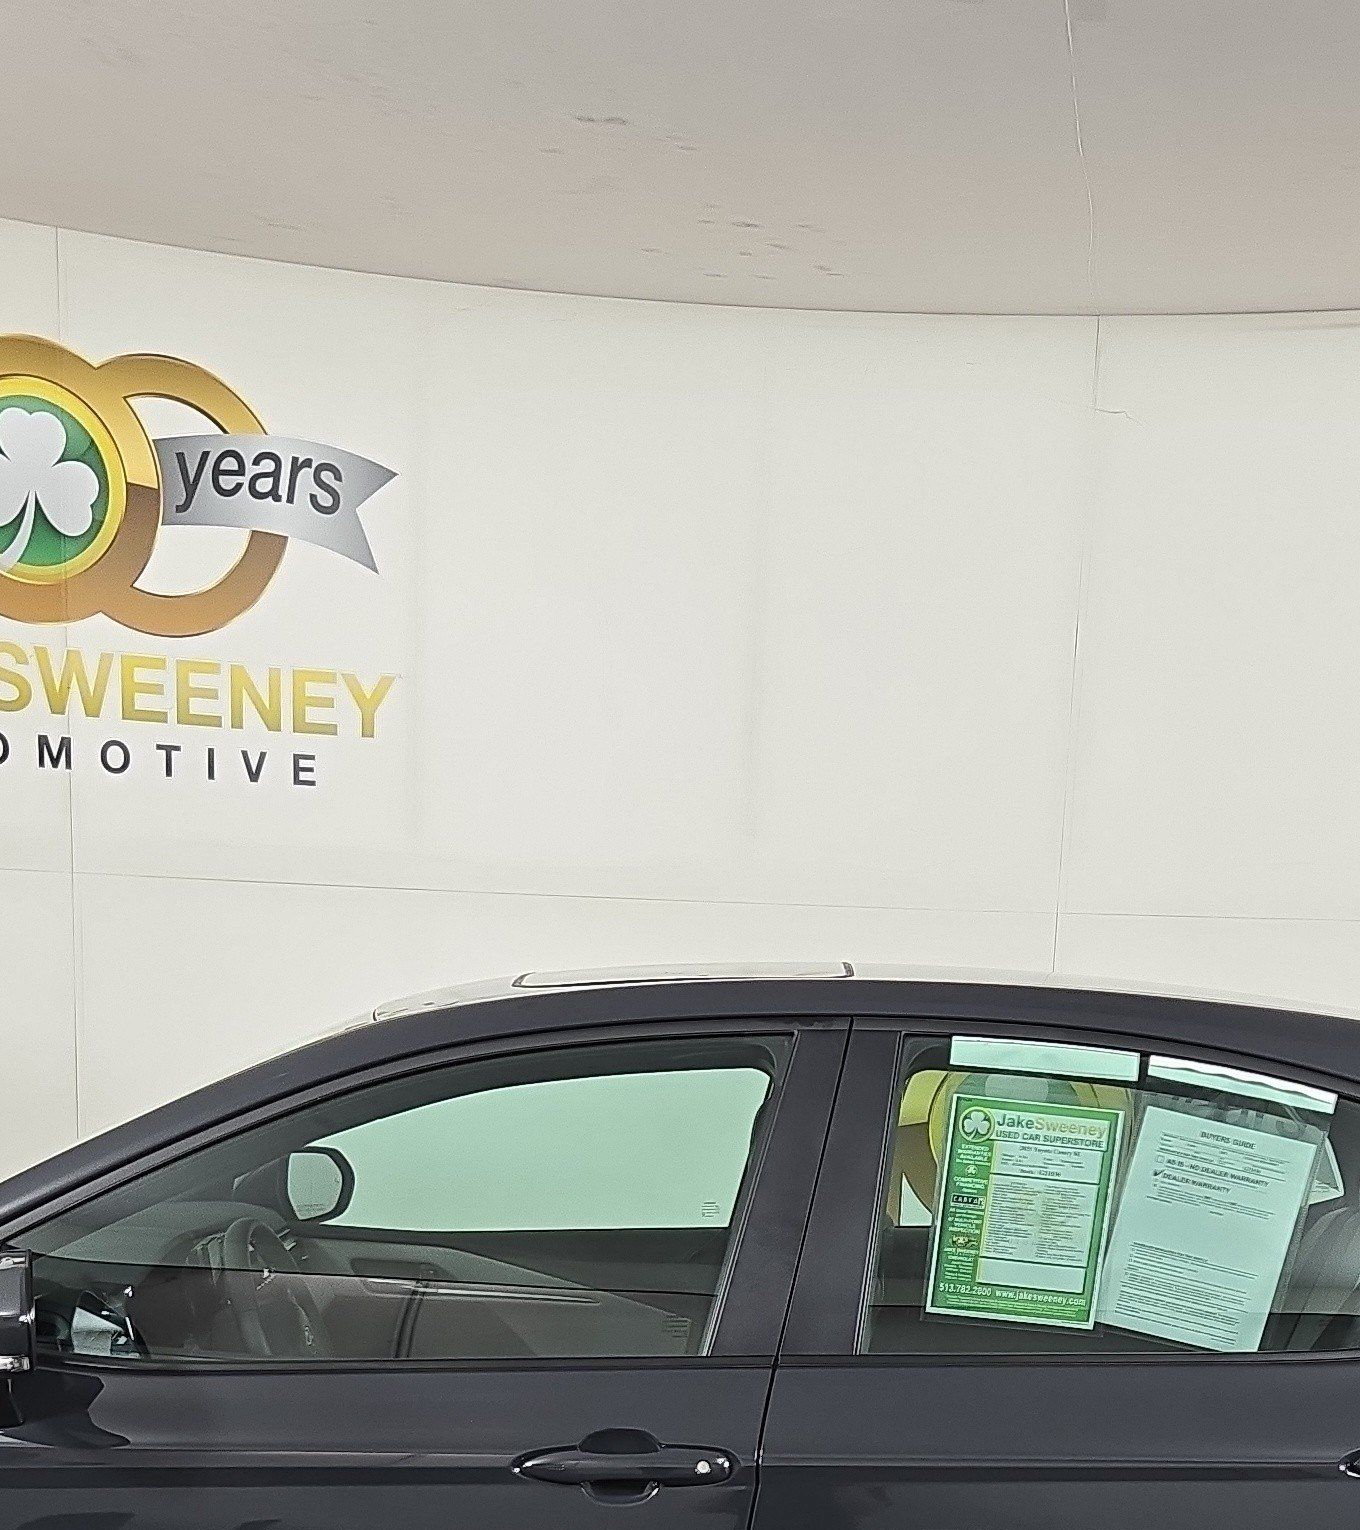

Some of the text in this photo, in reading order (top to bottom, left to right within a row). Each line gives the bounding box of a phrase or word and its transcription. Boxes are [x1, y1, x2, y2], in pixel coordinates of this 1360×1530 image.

[174, 448, 343, 514] years
[995, 1131, 1105, 1149] USED CAR SUPERSTORE
[1200, 1131, 1256, 1149] BUYERS GUIDE
[1162, 1172, 1191, 1184] DEALER
[1191, 1179, 1232, 1193] WARRANTY
[1190, 1163, 1201, 1171] NO
[1201, 1166, 1229, 1179] DEALER
[1230, 1174, 1270, 1187] WARRANTY
[995, 1289, 1086, 1307] www.jakesweeney.com
